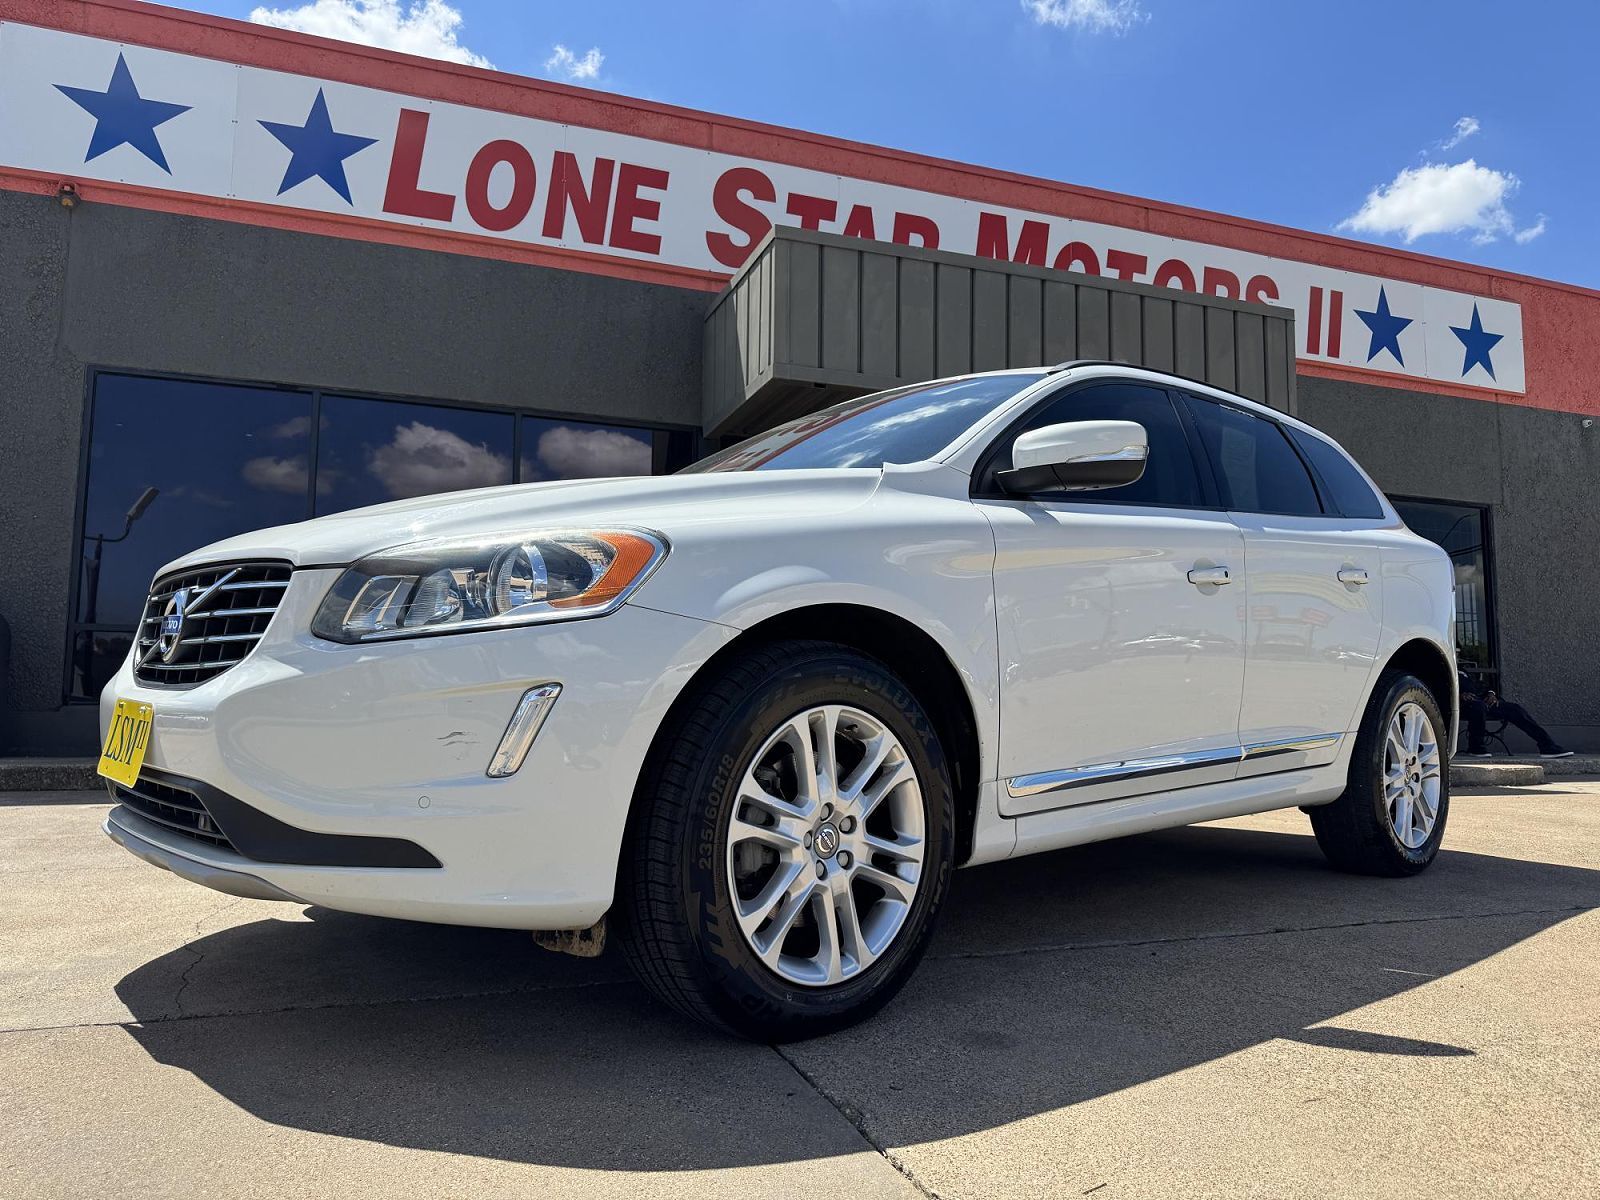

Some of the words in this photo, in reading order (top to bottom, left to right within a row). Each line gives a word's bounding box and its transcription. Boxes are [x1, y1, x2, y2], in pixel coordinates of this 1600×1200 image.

[383, 108, 670, 256] LONE
[1306, 285, 1343, 359] II
[698, 753, 735, 870] 235/60R18
